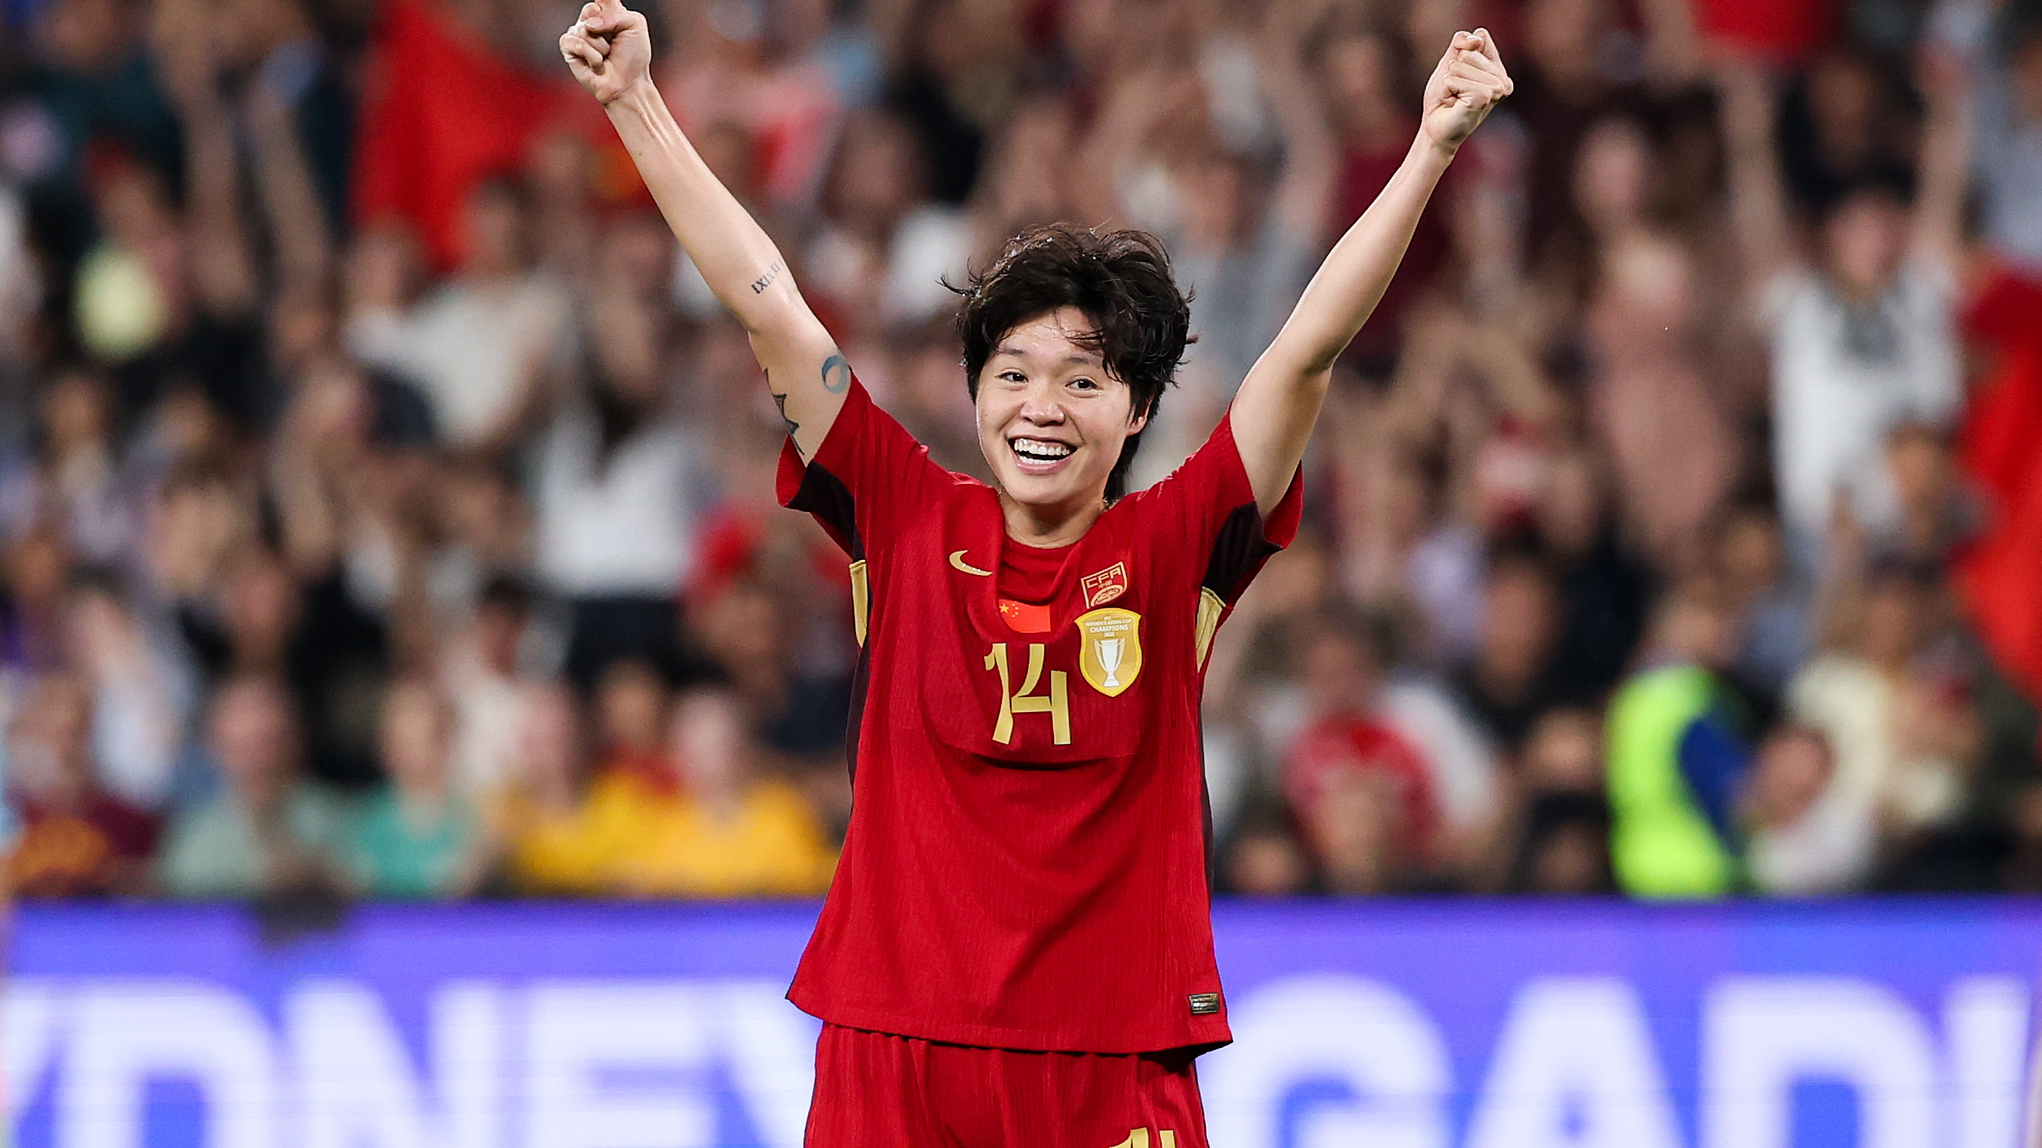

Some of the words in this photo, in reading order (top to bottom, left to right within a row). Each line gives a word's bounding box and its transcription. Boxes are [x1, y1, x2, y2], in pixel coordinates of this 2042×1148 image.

[1085, 567, 1121, 588] CFA
[1090, 624, 1129, 633] CHAMPIONS
[984, 643, 1071, 745] 14
